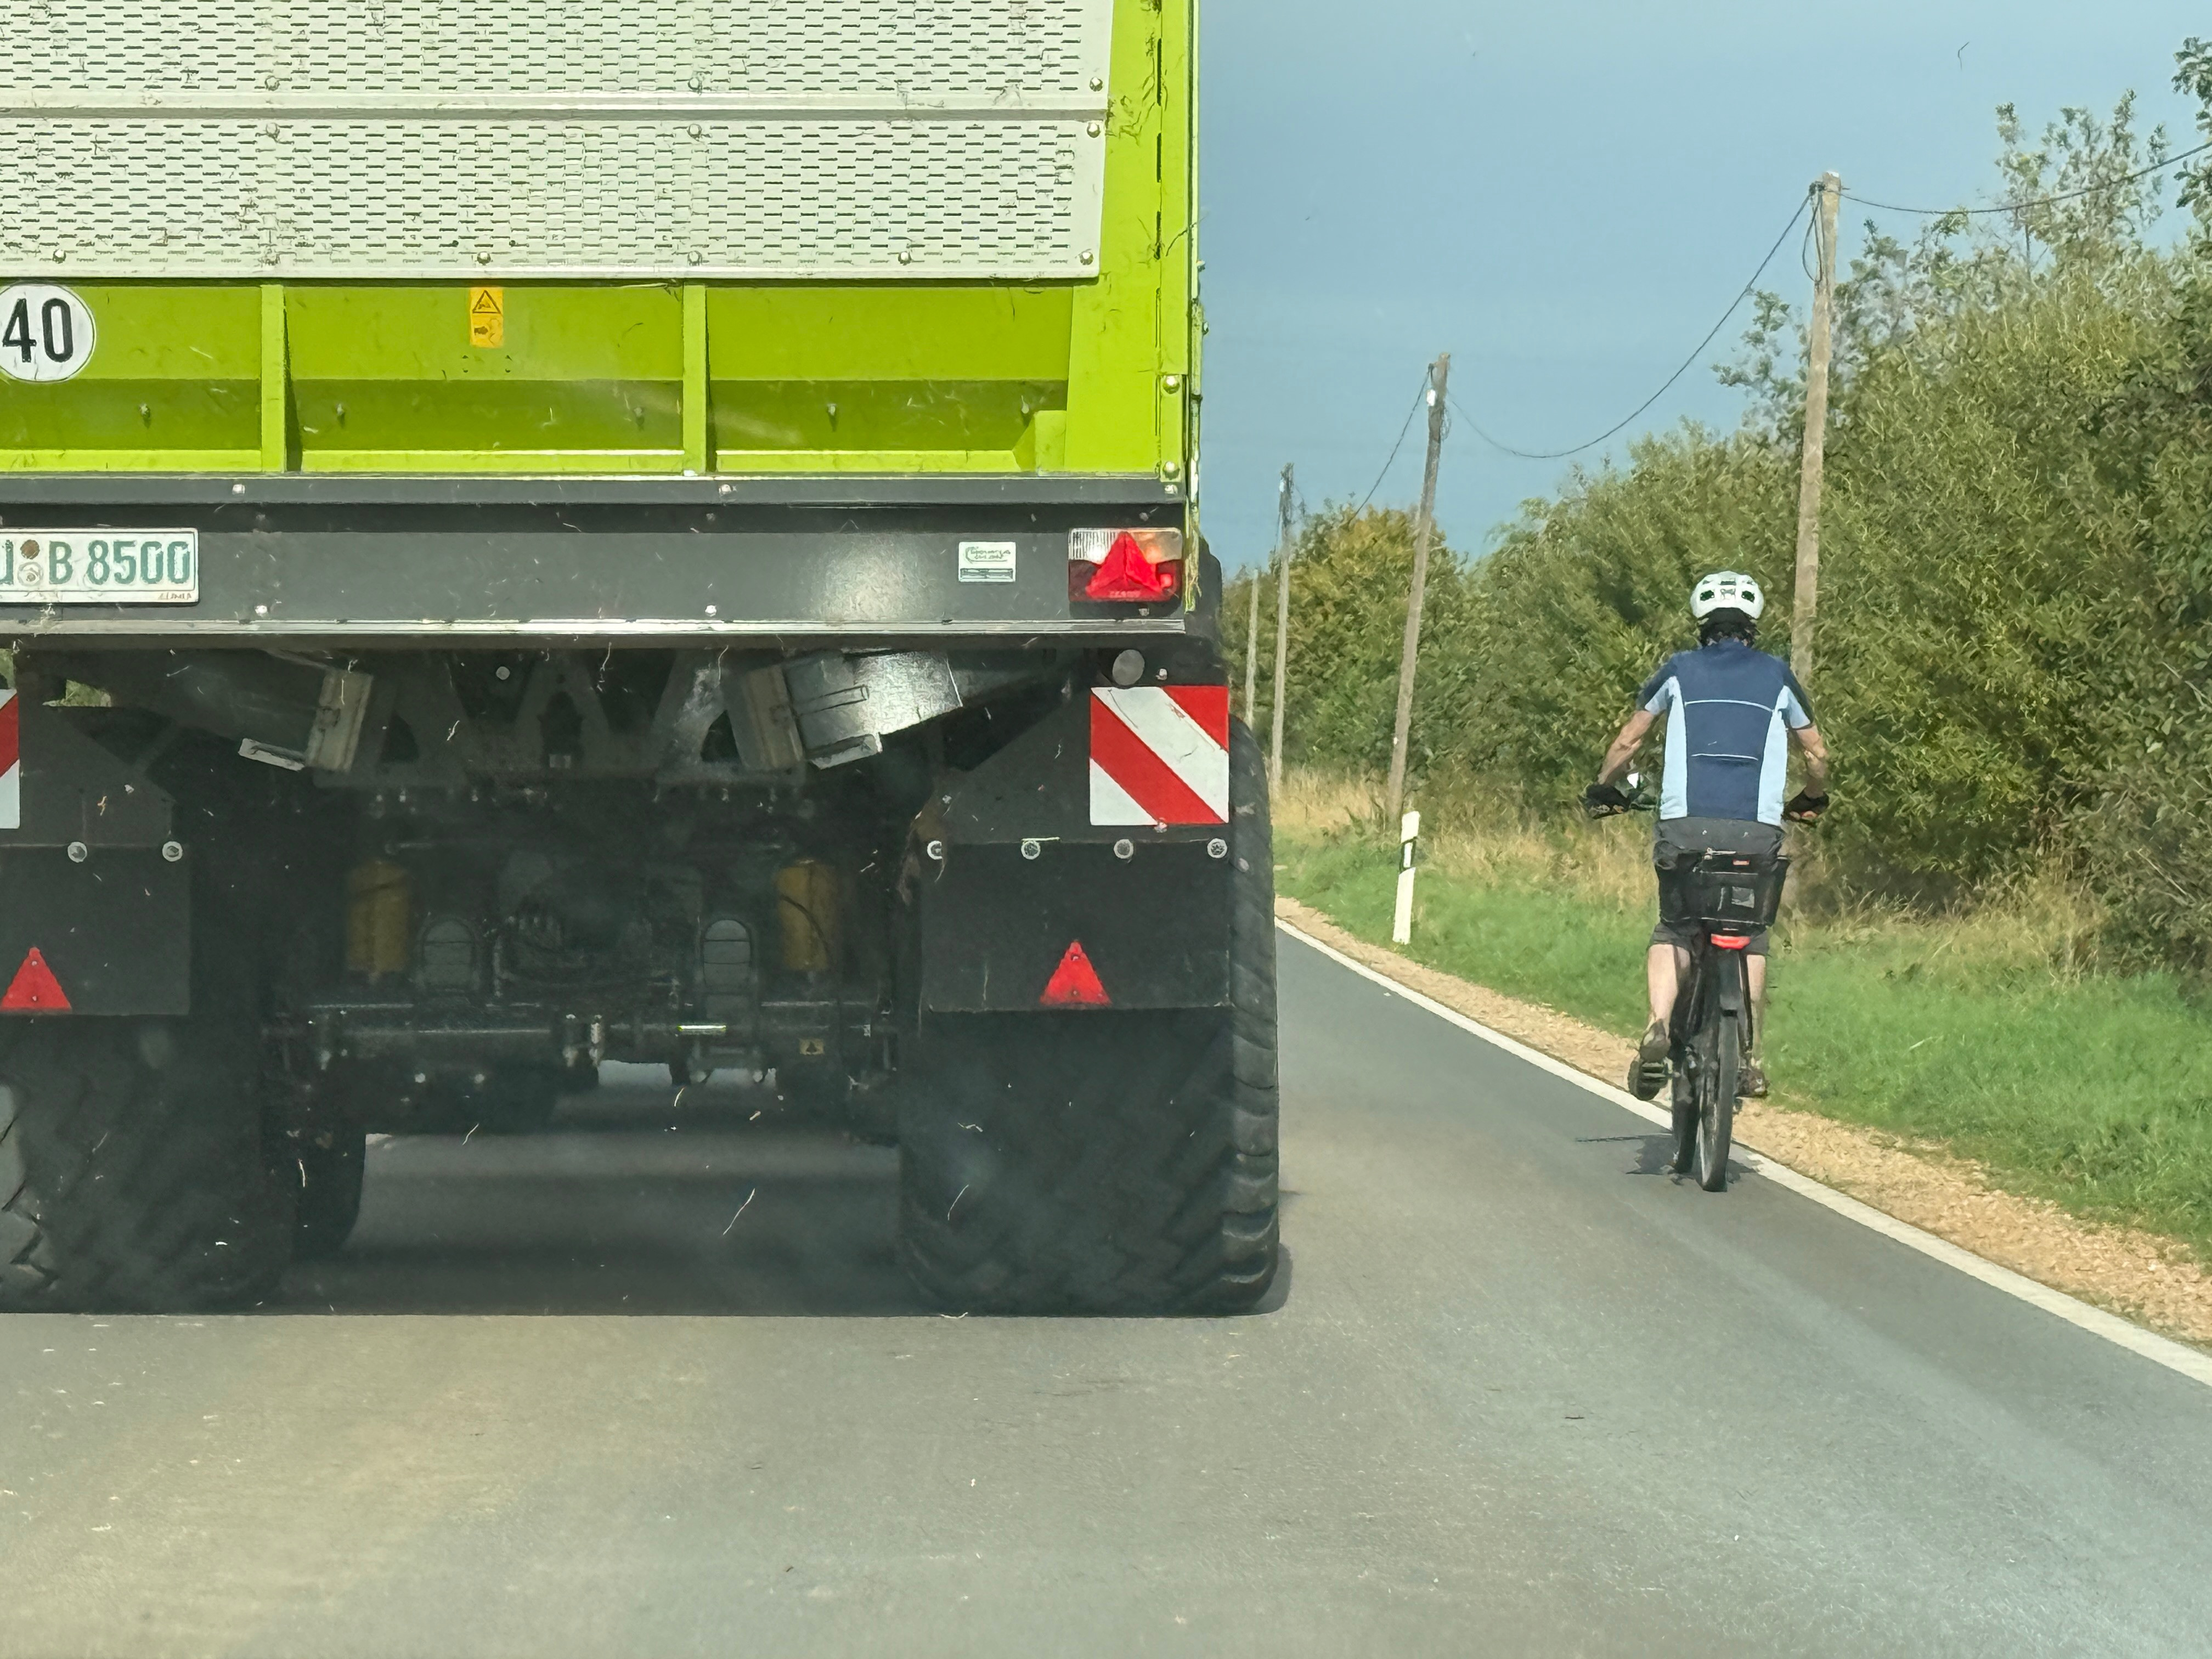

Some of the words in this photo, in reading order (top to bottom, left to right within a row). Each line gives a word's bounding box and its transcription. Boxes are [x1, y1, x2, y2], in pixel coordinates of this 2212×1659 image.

[3, 298, 74, 363] 40
[49, 540, 73, 585] B
[87, 540, 190, 585] 8500
